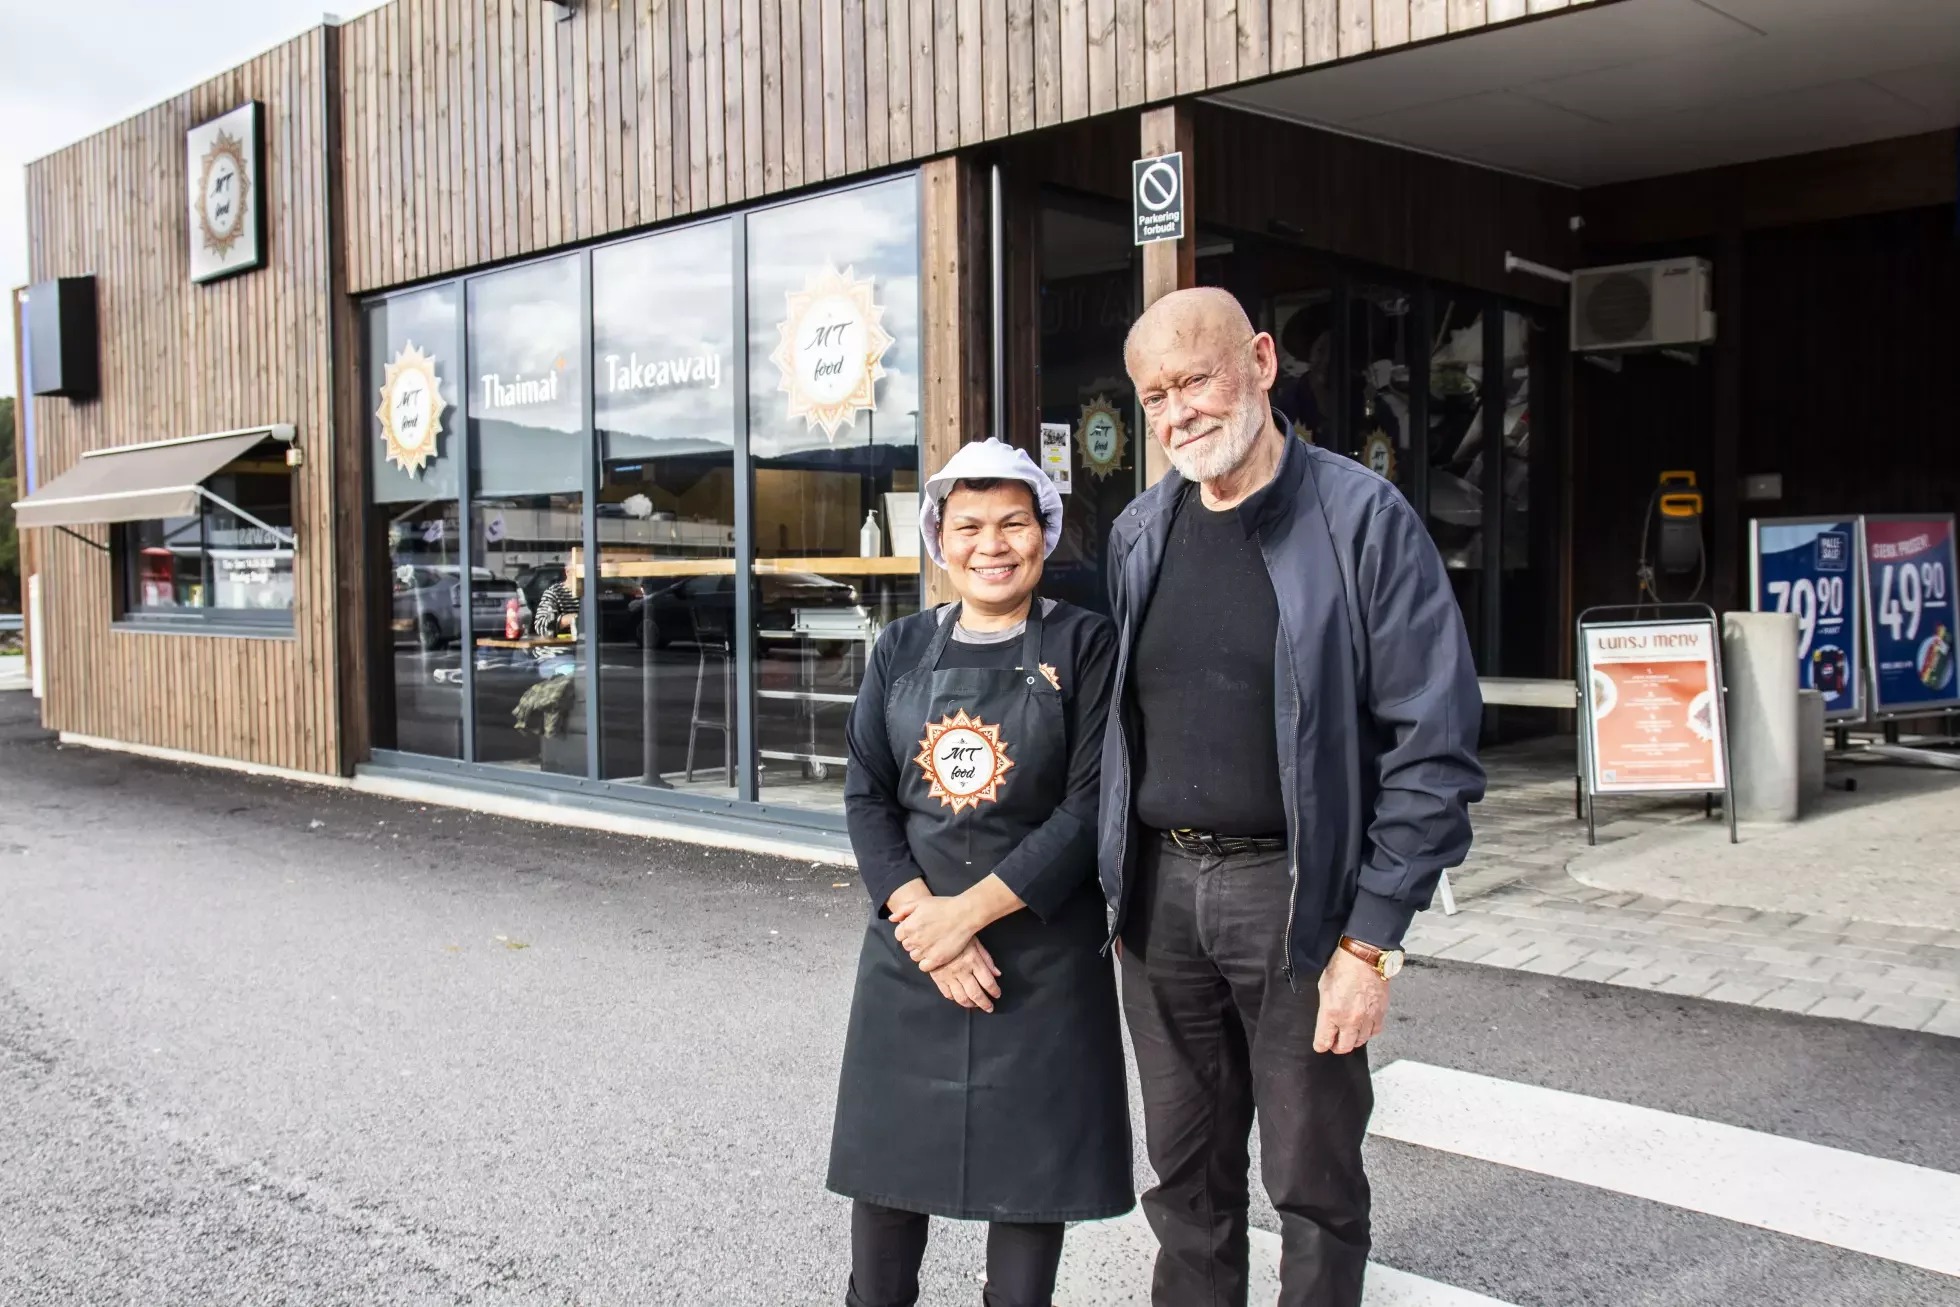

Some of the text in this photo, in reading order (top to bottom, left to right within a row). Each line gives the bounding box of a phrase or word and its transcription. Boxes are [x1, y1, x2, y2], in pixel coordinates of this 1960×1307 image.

[1139, 211, 1180, 226] Parkering
[1143, 222, 1175, 236] forbudt
[804, 321, 853, 351] MT
[604, 352, 722, 393] Takeaway
[813, 355, 844, 382] food
[396, 388, 423, 409] MT
[481, 370, 558, 409] Thaimat
[402, 414, 419, 433] food
[1878, 561, 1946, 641] 49 90
[941, 747, 983, 761] MT
[950, 766, 976, 780] food
